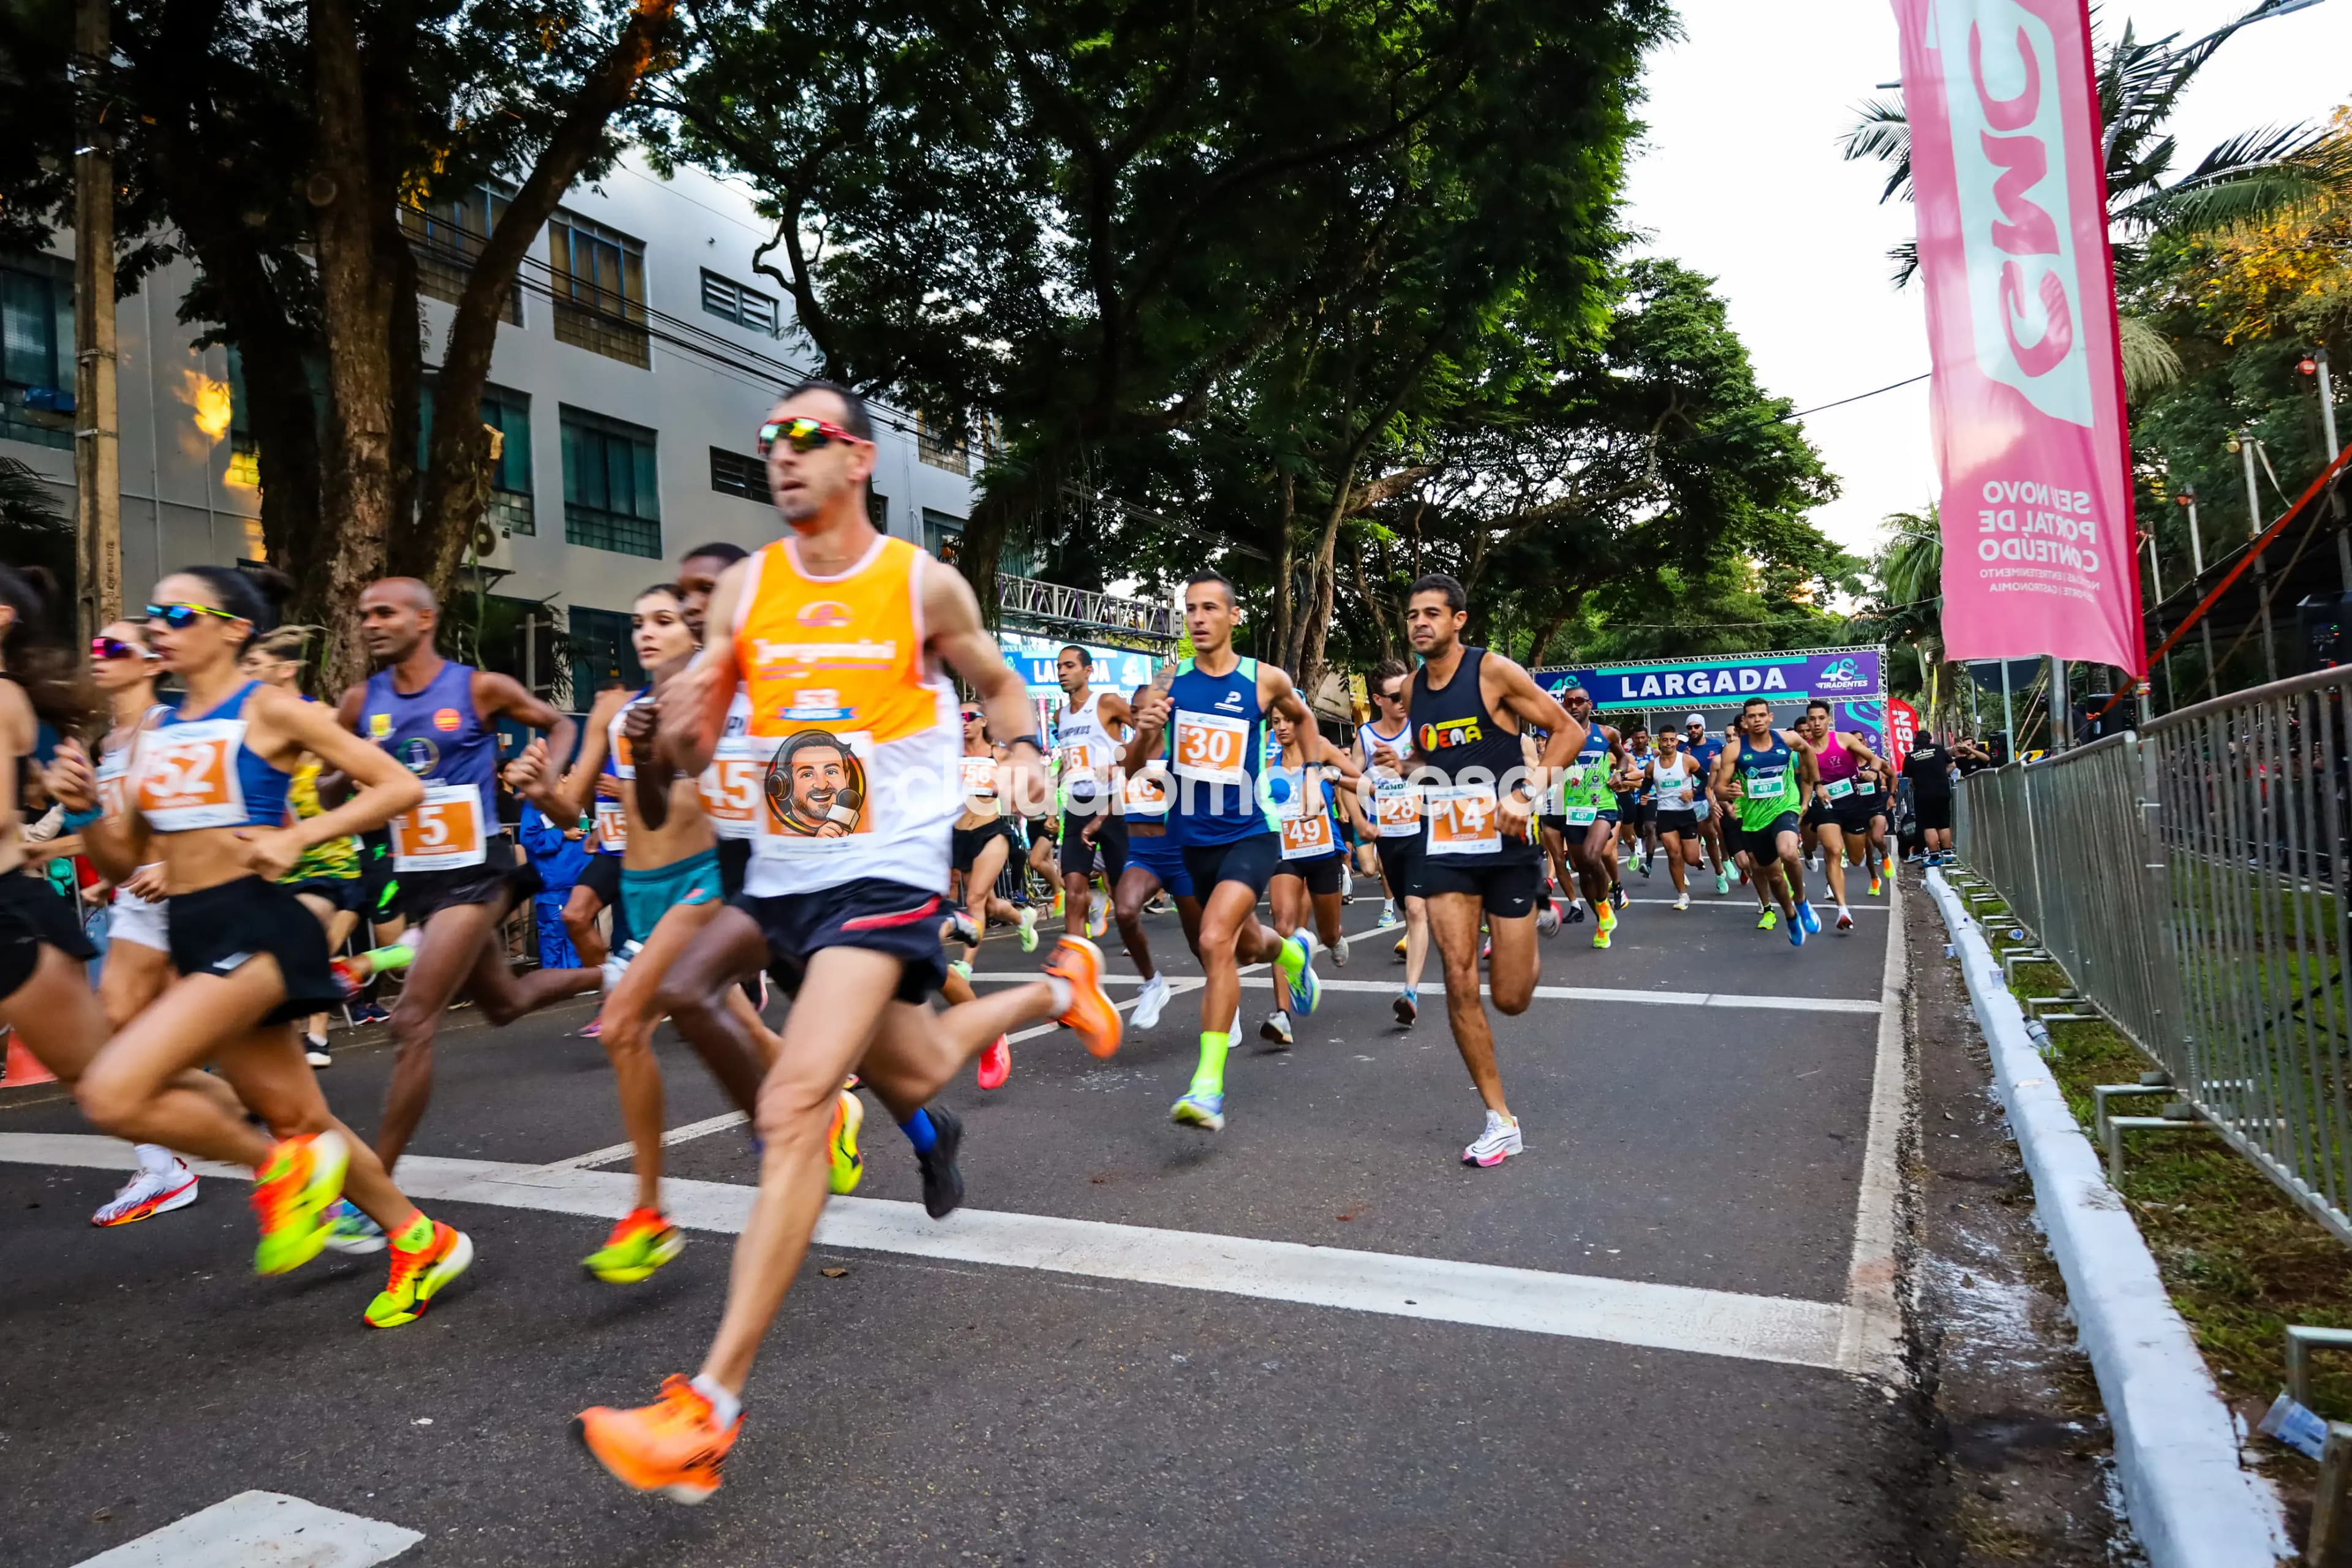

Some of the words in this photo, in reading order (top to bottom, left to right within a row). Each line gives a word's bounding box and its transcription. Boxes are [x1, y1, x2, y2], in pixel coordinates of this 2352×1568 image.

[1621, 667, 1787, 698] LARGADA
[1819, 680, 1868, 689] TIRADENTES
[1185, 727, 1231, 763] 30
[1891, 710, 1914, 755] CBN
[417, 806, 448, 845] 5
[1385, 798, 1415, 820] 28
[1445, 798, 1487, 834] 14
[1289, 819, 1321, 843] 49
